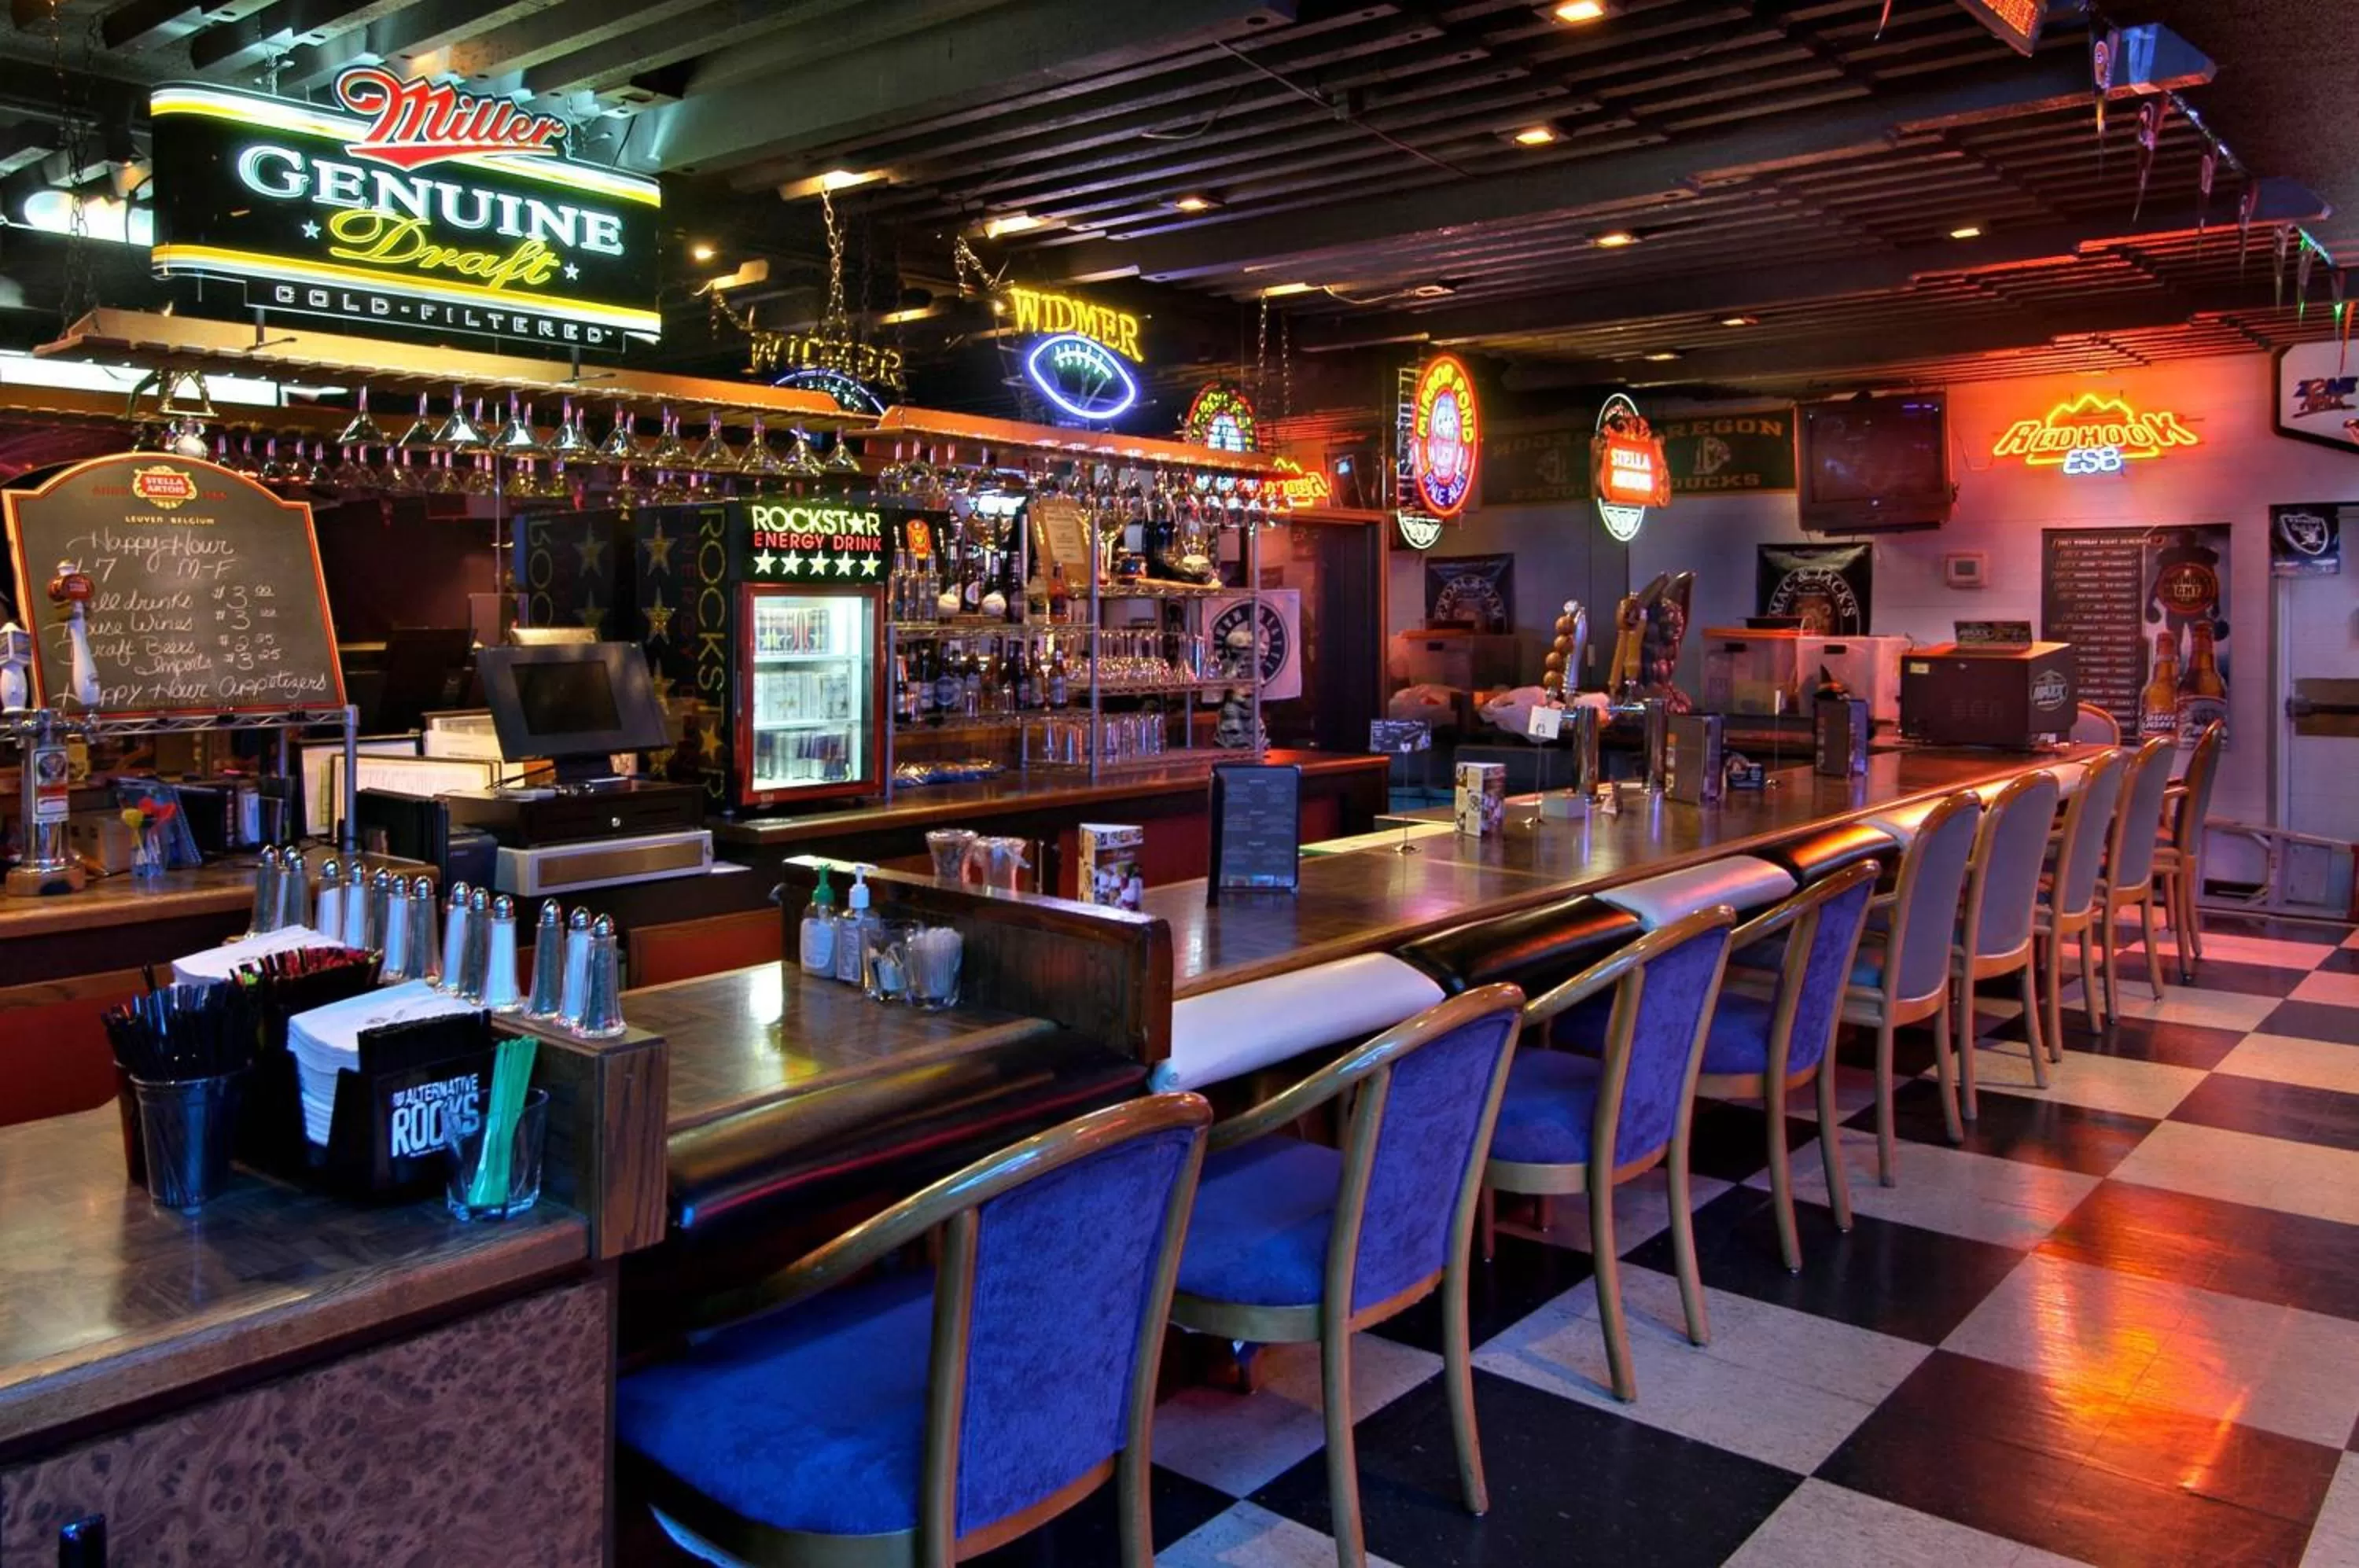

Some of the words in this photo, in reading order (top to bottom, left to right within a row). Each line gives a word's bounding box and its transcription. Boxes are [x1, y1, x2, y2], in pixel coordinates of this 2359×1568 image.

[338, 69, 567, 146] Miller
[238, 145, 624, 256] GENUINE
[329, 209, 561, 290] Draft
[1010, 288, 1144, 363] WIDMER
[1418, 364, 1453, 437] MIRROR
[1452, 377, 1474, 443] POND
[1665, 418, 1785, 440] REGON
[1993, 411, 2199, 455] REDHOOK
[1610, 447, 1651, 469] STELLA
[2063, 446, 2122, 474] ESB
[66, 528, 160, 572] Happy
[160, 530, 235, 555] Hour
[754, 532, 825, 549] ENERGY
[833, 535, 881, 551] DRINK
[123, 589, 193, 612] drinks
[1770, 581, 1795, 615] MAC
[131, 611, 193, 632] Wines
[405, 1073, 478, 1106] ALTERNATIVE
